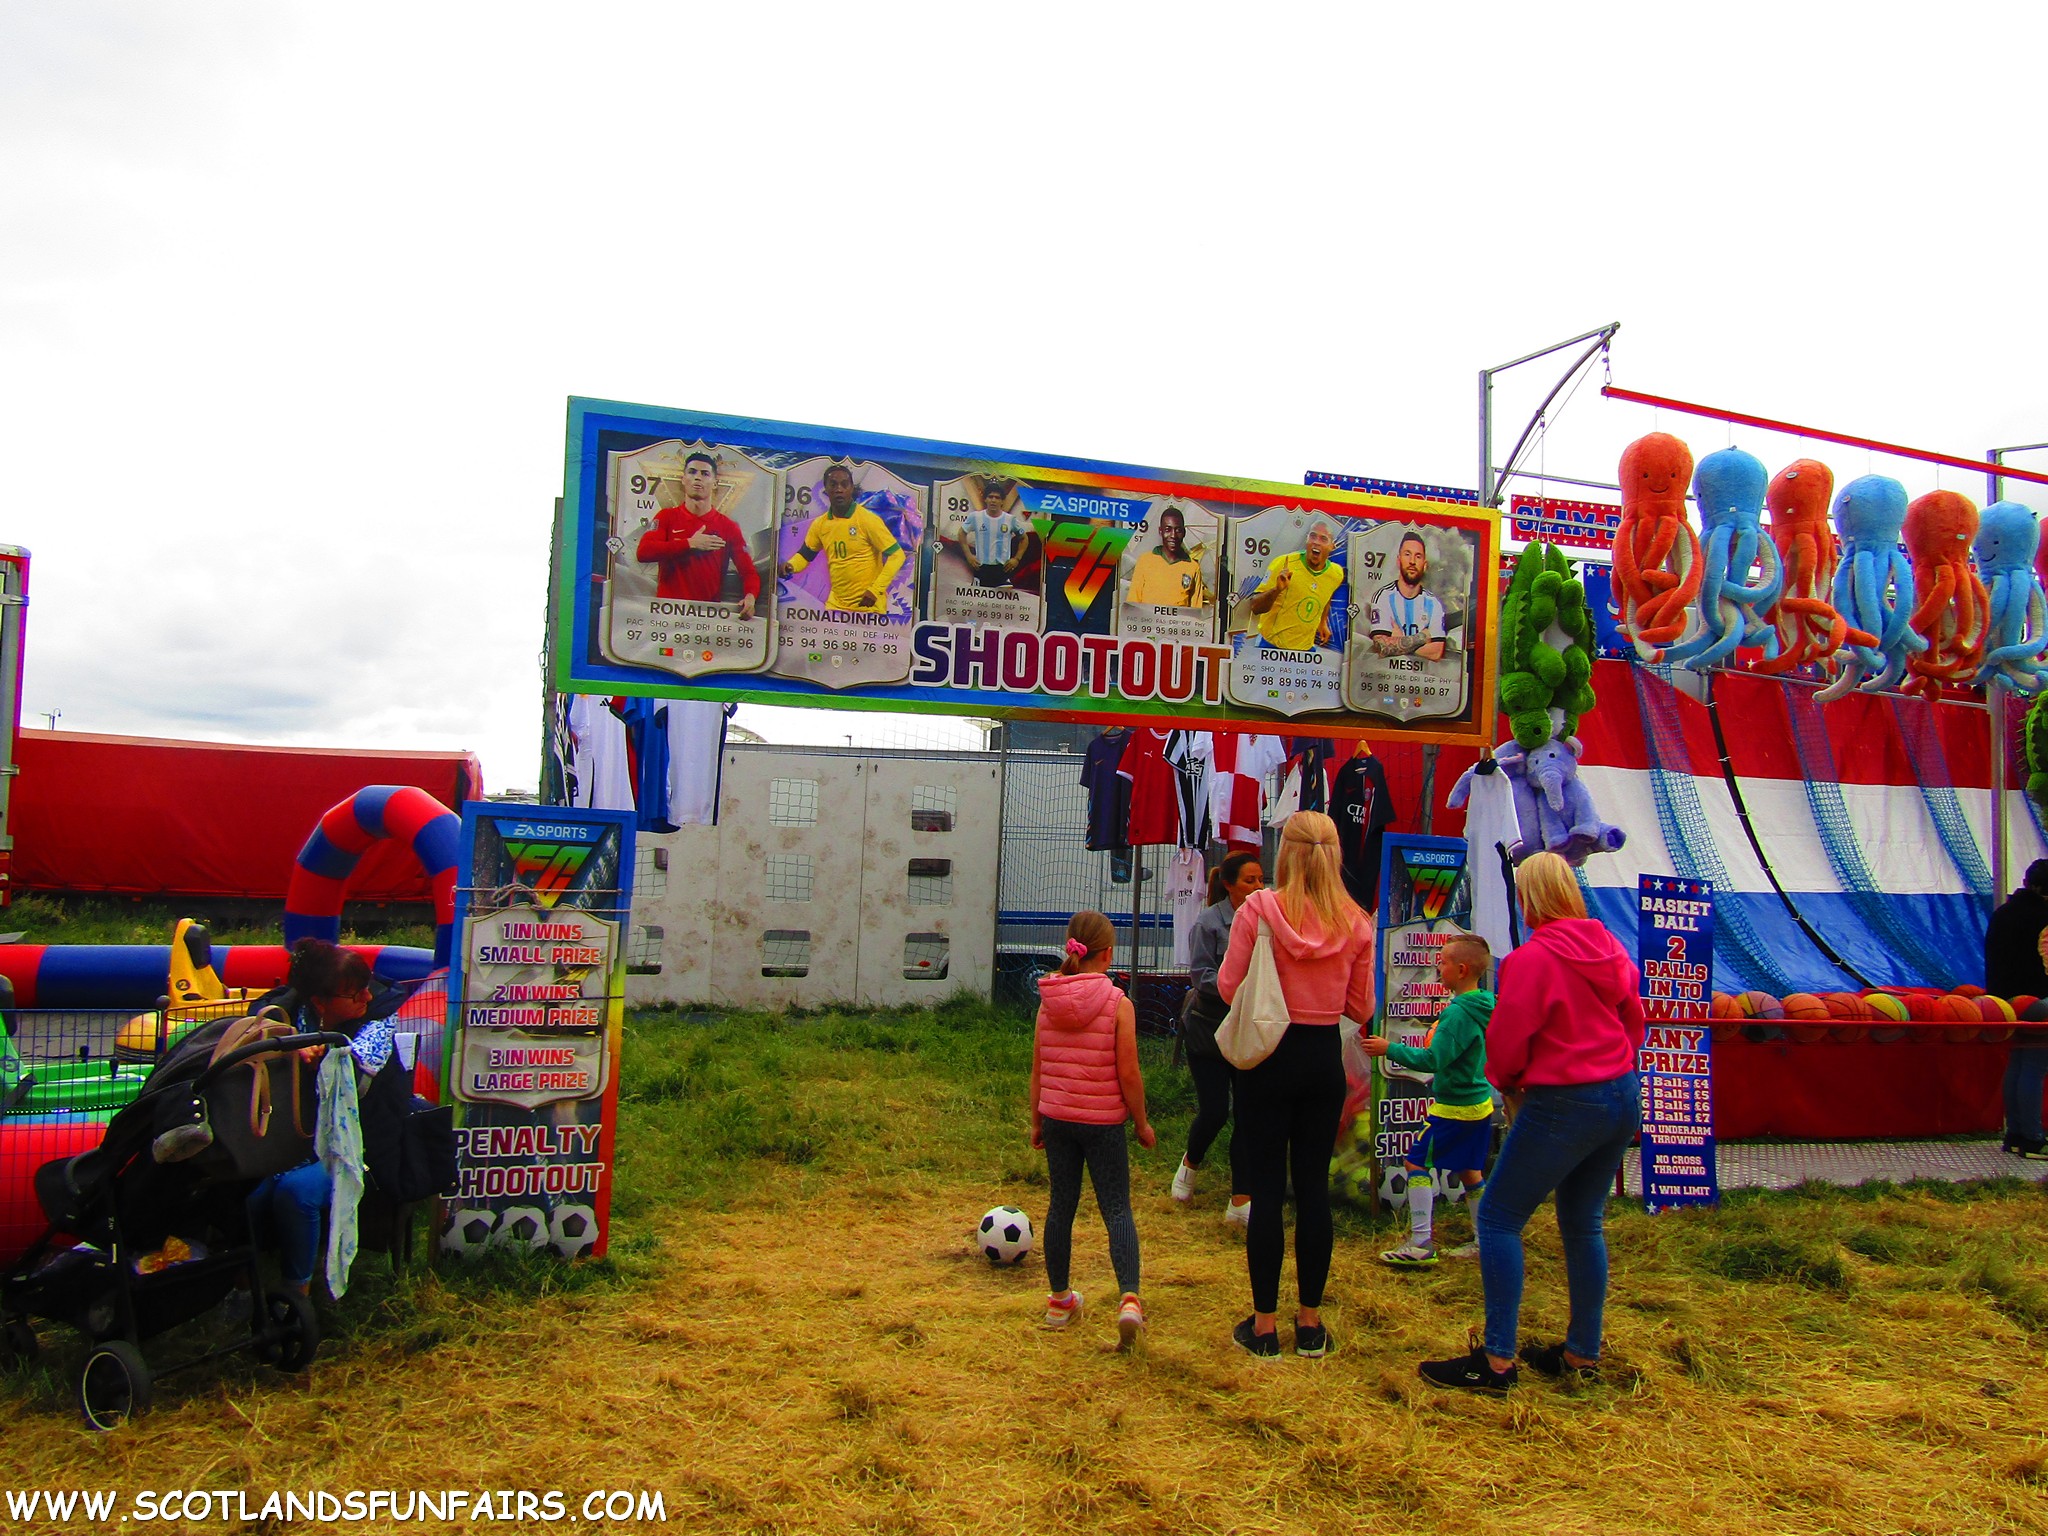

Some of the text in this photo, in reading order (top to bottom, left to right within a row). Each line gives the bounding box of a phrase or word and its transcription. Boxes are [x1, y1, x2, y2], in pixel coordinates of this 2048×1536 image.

[630, 474, 661, 495] 97
[786, 484, 812, 505] 96
[637, 499, 655, 509] LW
[948, 496, 970, 512] 98
[1040, 494, 1130, 518] EA SPORTS
[784, 508, 809, 519] CAM
[834, 541, 846, 559] 10
[1244, 537, 1270, 557] 96
[1252, 559, 1264, 568] ST
[1364, 551, 1386, 568] 97
[1367, 572, 1382, 581] RW
[956, 587, 1019, 601] MARADONA
[650, 602, 730, 619] RONALDO
[786, 608, 889, 626] RONALDINHO
[1154, 606, 1178, 616] PELE
[627, 618, 643, 626] PAC
[650, 620, 668, 628] SHO
[801, 626, 817, 634] SHO
[627, 630, 753, 648] 97 99 93 94 85 96
[779, 636, 897, 654] 95 94 96 98 76 93
[910, 622, 1233, 705] SHOOTOUT
[1261, 650, 1322, 664] RONALDO
[1389, 659, 1423, 671] MESSI
[1243, 675, 1340, 690] 97 98 89 96 74 90
[1361, 682, 1449, 696] 95 98 98 99 80 87
[513, 824, 587, 839] EA SPORTS
[1412, 852, 1455, 864] EA SPORTS
[1641, 896, 1711, 916] BASKET
[1654, 914, 1699, 932] BALL
[504, 923, 582, 940] 1 IN WINS
[1407, 933, 1411, 947] 1
[1413, 933, 1423, 946] IN
[479, 946, 601, 964] SMALL PRIZE
[1667, 935, 1685, 961] 2
[1393, 952, 1432, 966] SMALL
[1644, 960, 1707, 981] BALLS
[493, 985, 579, 1001] 2 IN WINS
[1402, 983, 1409, 997] 2
[1411, 983, 1422, 997] IN
[1649, 979, 1702, 1000] IN TO
[1388, 1002, 1431, 1016] MEDIUM
[1640, 997, 1710, 1028] WIN
[468, 1008, 598, 1026] MEDIUM PRIZE
[1409, 1035, 1420, 1047] IN
[1645, 1027, 1704, 1050] ANY
[490, 1048, 575, 1066] 3 IN WINS
[1639, 1050, 1710, 1075] PRIZE
[473, 1072, 589, 1091] LARGE PRIZE
[1640, 1076, 1709, 1089] 4 Balls £4
[1640, 1088, 1709, 1100] 5 Balls £5
[1641, 1099, 1710, 1111] 6 Balls £6
[1642, 1110, 1710, 1123] 7 Balls £7
[1642, 1124, 1711, 1135] NO UNDERARM
[452, 1124, 602, 1158] PENALTY
[1651, 1134, 1705, 1145] THROWING
[1656, 1154, 1702, 1165] NO CROSS
[1653, 1164, 1706, 1175] THROWING
[1650, 1183, 1710, 1196] 1 WIN LIMIT
